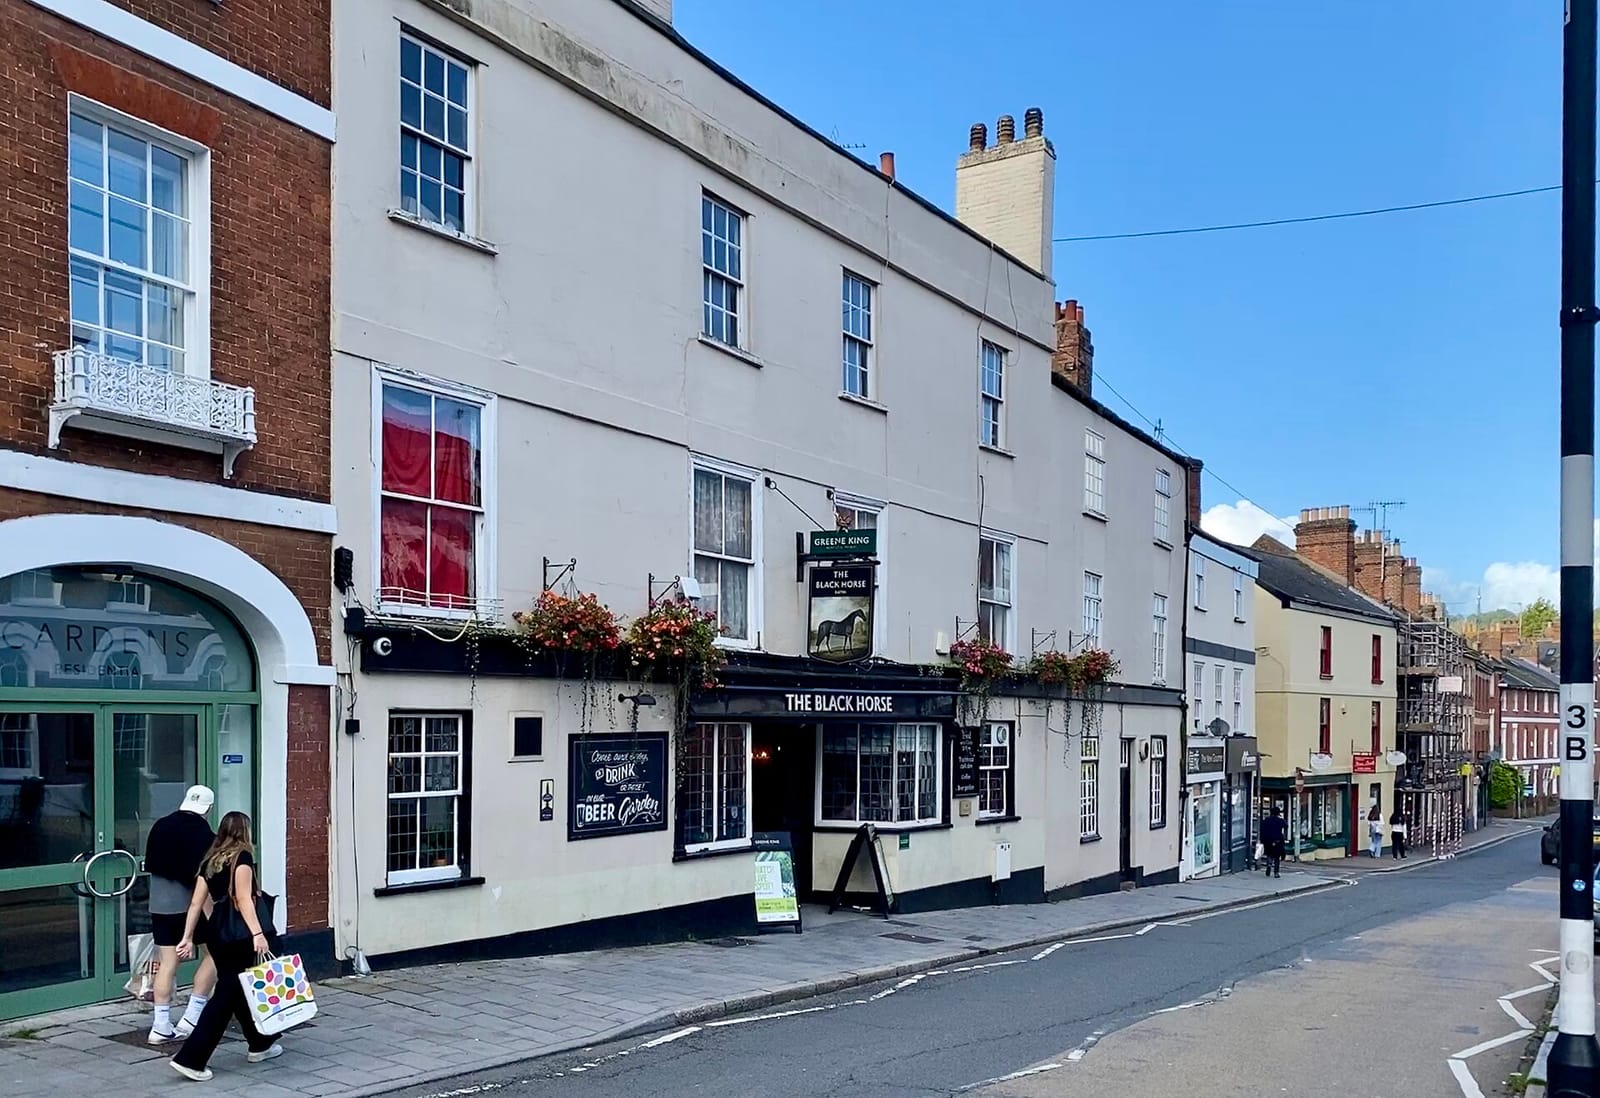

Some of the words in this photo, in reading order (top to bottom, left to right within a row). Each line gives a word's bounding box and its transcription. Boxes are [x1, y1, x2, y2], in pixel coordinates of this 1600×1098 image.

[814, 536, 846, 546] GREENE
[848, 536, 870, 545] KING
[833, 570, 849, 578] THE
[815, 581, 840, 589] BLACK
[841, 580, 867, 588] HORSE
[785, 693, 812, 711] THE
[814, 694, 854, 712] BLACK
[856, 695, 893, 712] HORSE
[1567, 705, 1586, 729] 3
[1566, 737, 1586, 760] B
[605, 763, 636, 783] DRINK
[585, 802, 615, 822] BEER
[618, 794, 659, 826] Garden
